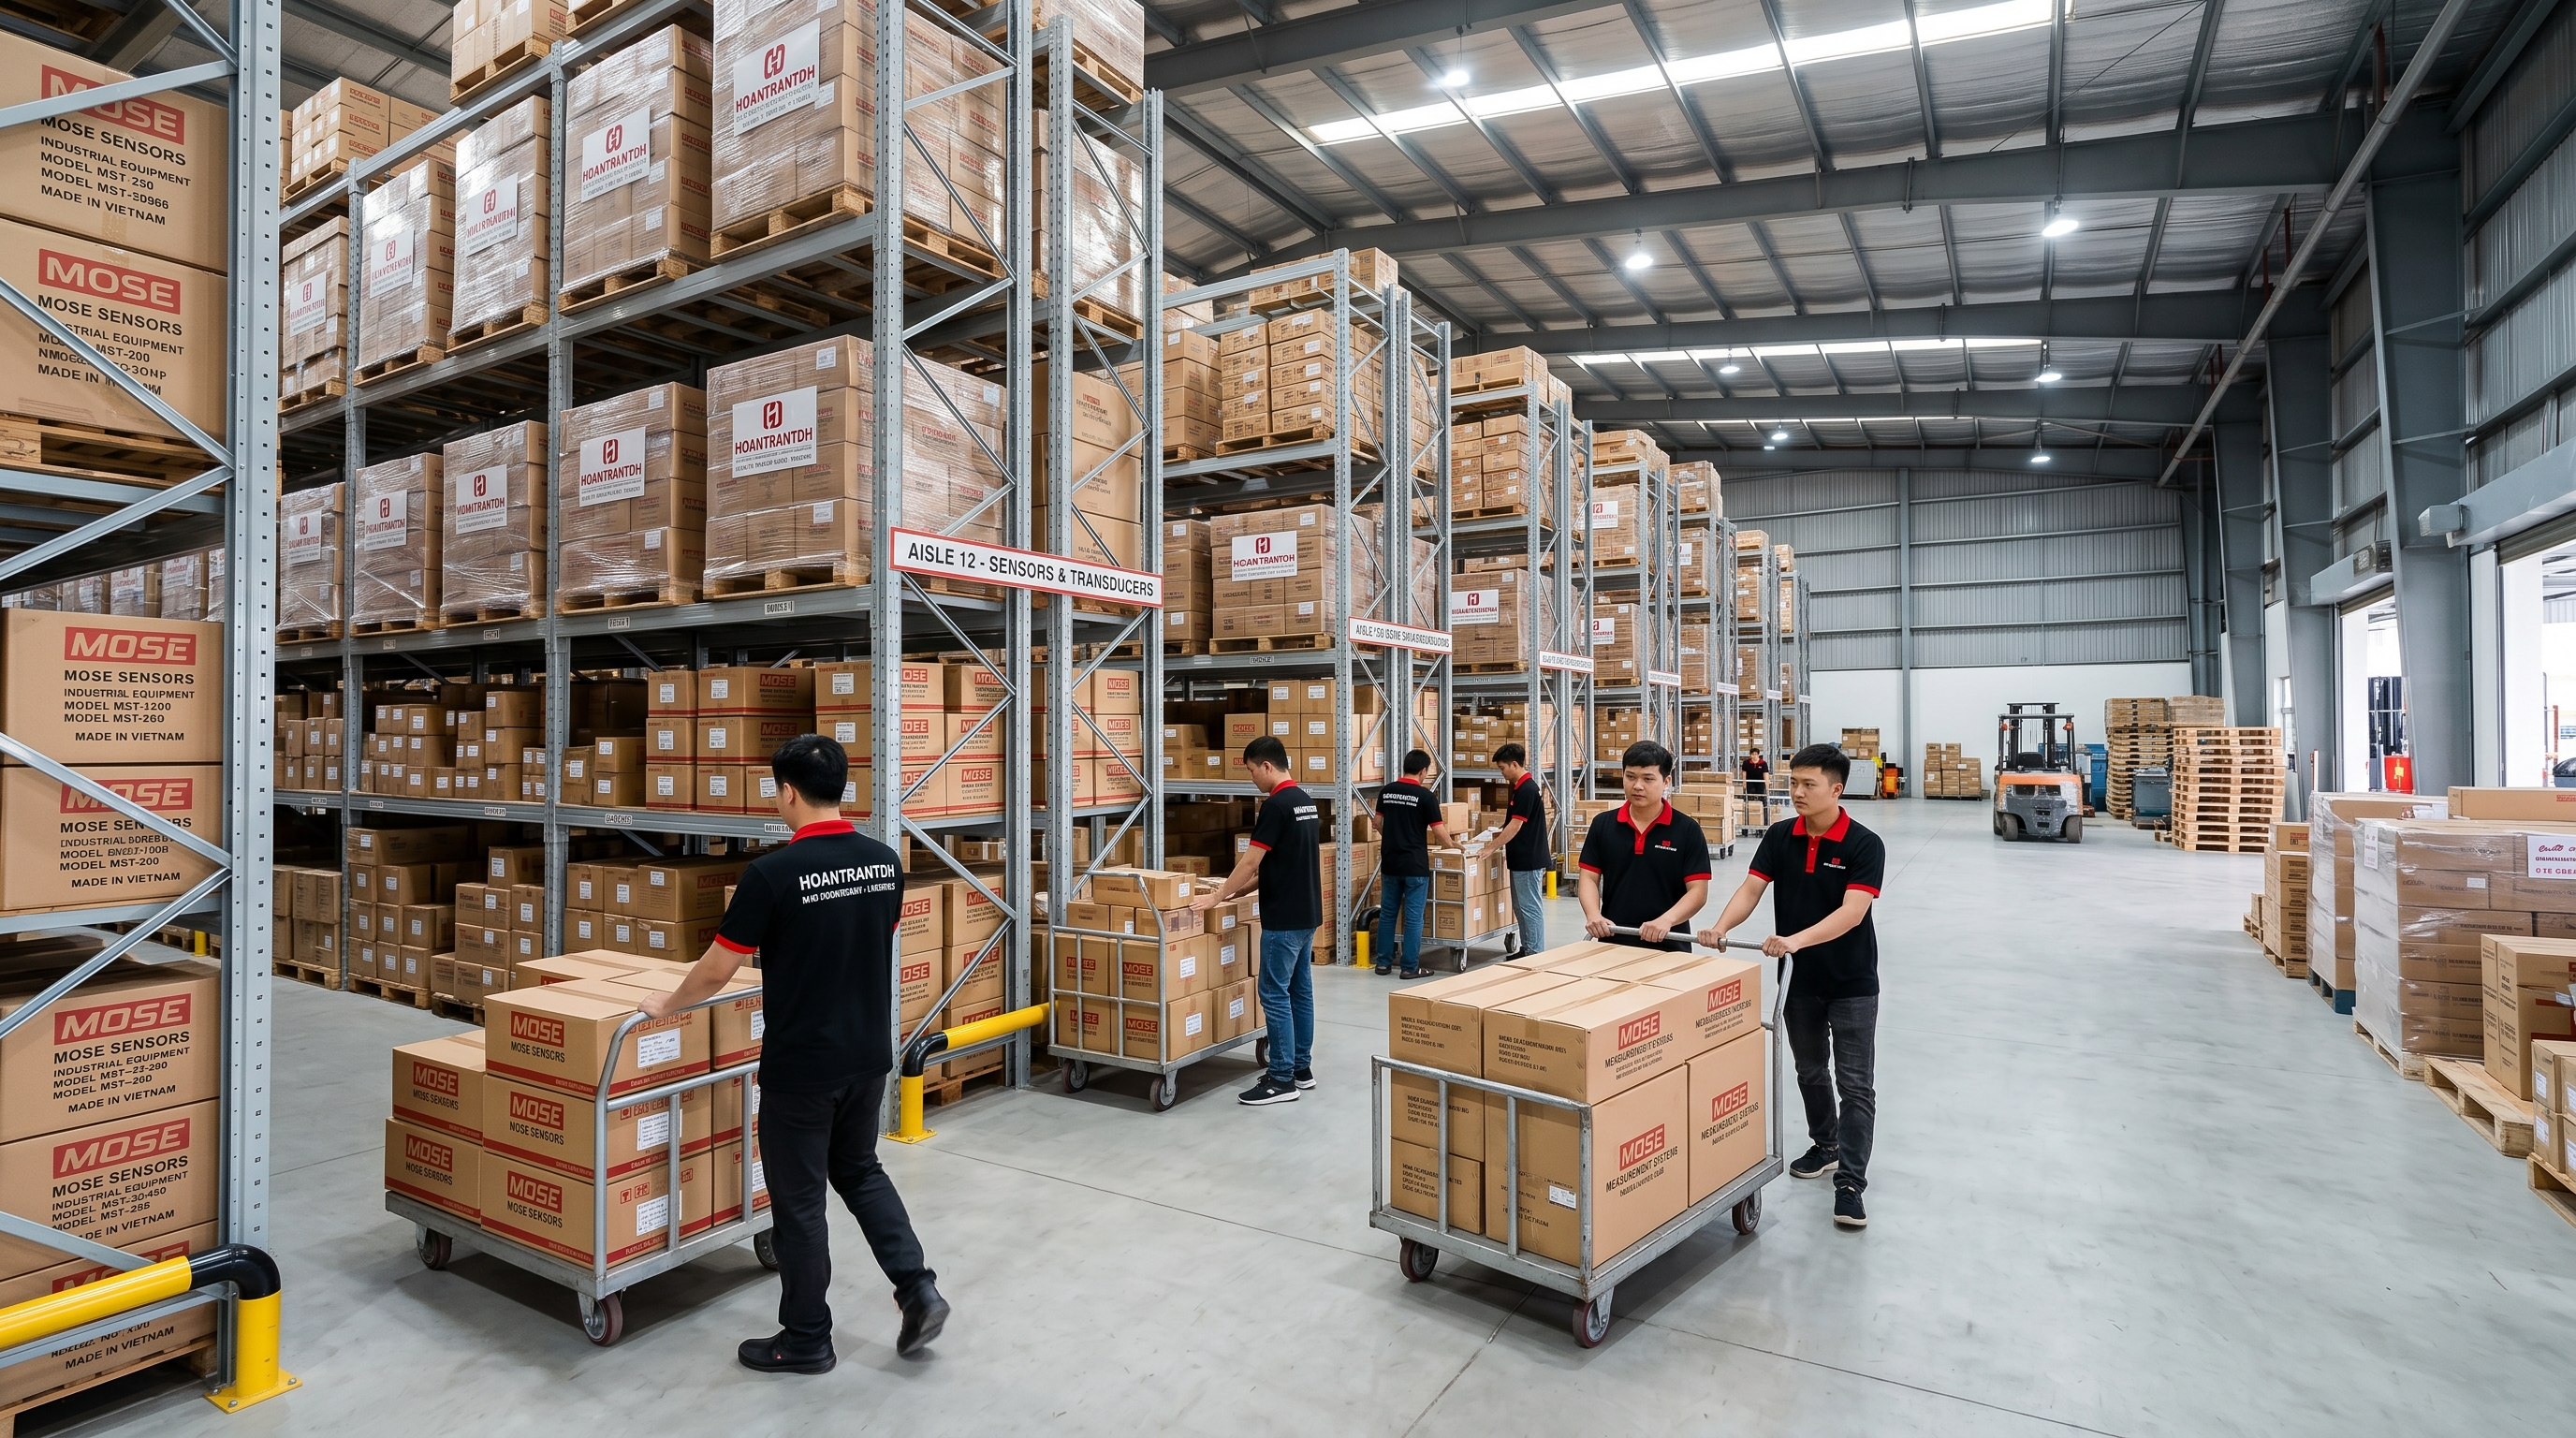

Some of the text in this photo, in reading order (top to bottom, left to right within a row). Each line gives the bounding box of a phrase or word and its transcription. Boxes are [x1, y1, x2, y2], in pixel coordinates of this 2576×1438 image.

[737, 65, 814, 112] HOANTRANTDH
[41, 116, 186, 165] MOSE SENSORS
[41, 137, 190, 186] INDUSTRIAL EQUIPMENT
[41, 152, 92, 173] MODEL
[583, 143, 646, 183] HOANTRANTDH
[41, 168, 92, 189] MODEL
[41, 185, 165, 225] MADE IN VIETNAM
[47, 257, 173, 307] MOSE
[38, 295, 183, 335] MOSE SENSORS
[113, 333, 183, 355] EQUIPMENT
[38, 364, 98, 383] MADE IN
[735, 427, 812, 454] HOANTRANTDH
[581, 463, 641, 486] HOANTRANTDH
[908, 543, 954, 565] AISLE
[960, 551, 974, 568] 12
[989, 556, 1054, 581] SENSORS
[1058, 568, 1066, 583] &
[1071, 570, 1153, 596] TRANSDUCERS
[71, 633, 191, 660] MOSE
[65, 670, 194, 683] MOSE SENSORS
[65, 701, 110, 710] MODEL
[133, 690, 195, 698] EQUIPMENT
[65, 714, 164, 723] MODEL MST-260
[60, 821, 108, 832] MOSE
[60, 850, 103, 858] MODEL
[60, 858, 159, 871] MODEL MST-200
[71, 878, 108, 888] MADE
[127, 873, 180, 883] VIETNAM
[799, 864, 895, 890] HOANTRANTDH
[902, 965, 928, 980] OSE
[1709, 983, 1739, 1009] MOSE
[61, 999, 185, 1040] MOSE
[513, 1016, 562, 1043] MOSE
[1620, 1015, 1658, 1047] MOSE
[54, 1032, 190, 1064] MOSE SENSORS
[511, 1041, 530, 1054] MOSE
[54, 1047, 190, 1078] INDUSTRIAL EQUIPMENT
[53, 1075, 95, 1089] MODEL
[53, 1086, 96, 1099] MODEL
[416, 1065, 456, 1093] MOSE
[68, 1085, 176, 1113] MADE IN VIETNAM
[513, 1097, 562, 1123] MOSE
[1714, 1085, 1746, 1118] MOSE
[60, 1123, 184, 1172] MOSE
[531, 1127, 564, 1145] SENSORS
[1622, 1128, 1662, 1167] MOSE
[408, 1138, 450, 1167] MOSE
[52, 1156, 188, 1197] MOSE SENSORS
[52, 1171, 188, 1211] INDUSTRIAL EQUIPMENT
[510, 1176, 560, 1209] MOSE
[52, 1206, 96, 1222] MODEL
[52, 1217, 95, 1230] MODEL
[106, 1226, 118, 1235] IN
[122, 1210, 174, 1229] VIETNAM
[66, 1350, 102, 1369] MADE
[106, 1346, 118, 1356] IN
[121, 1326, 174, 1350] VIETNAM
